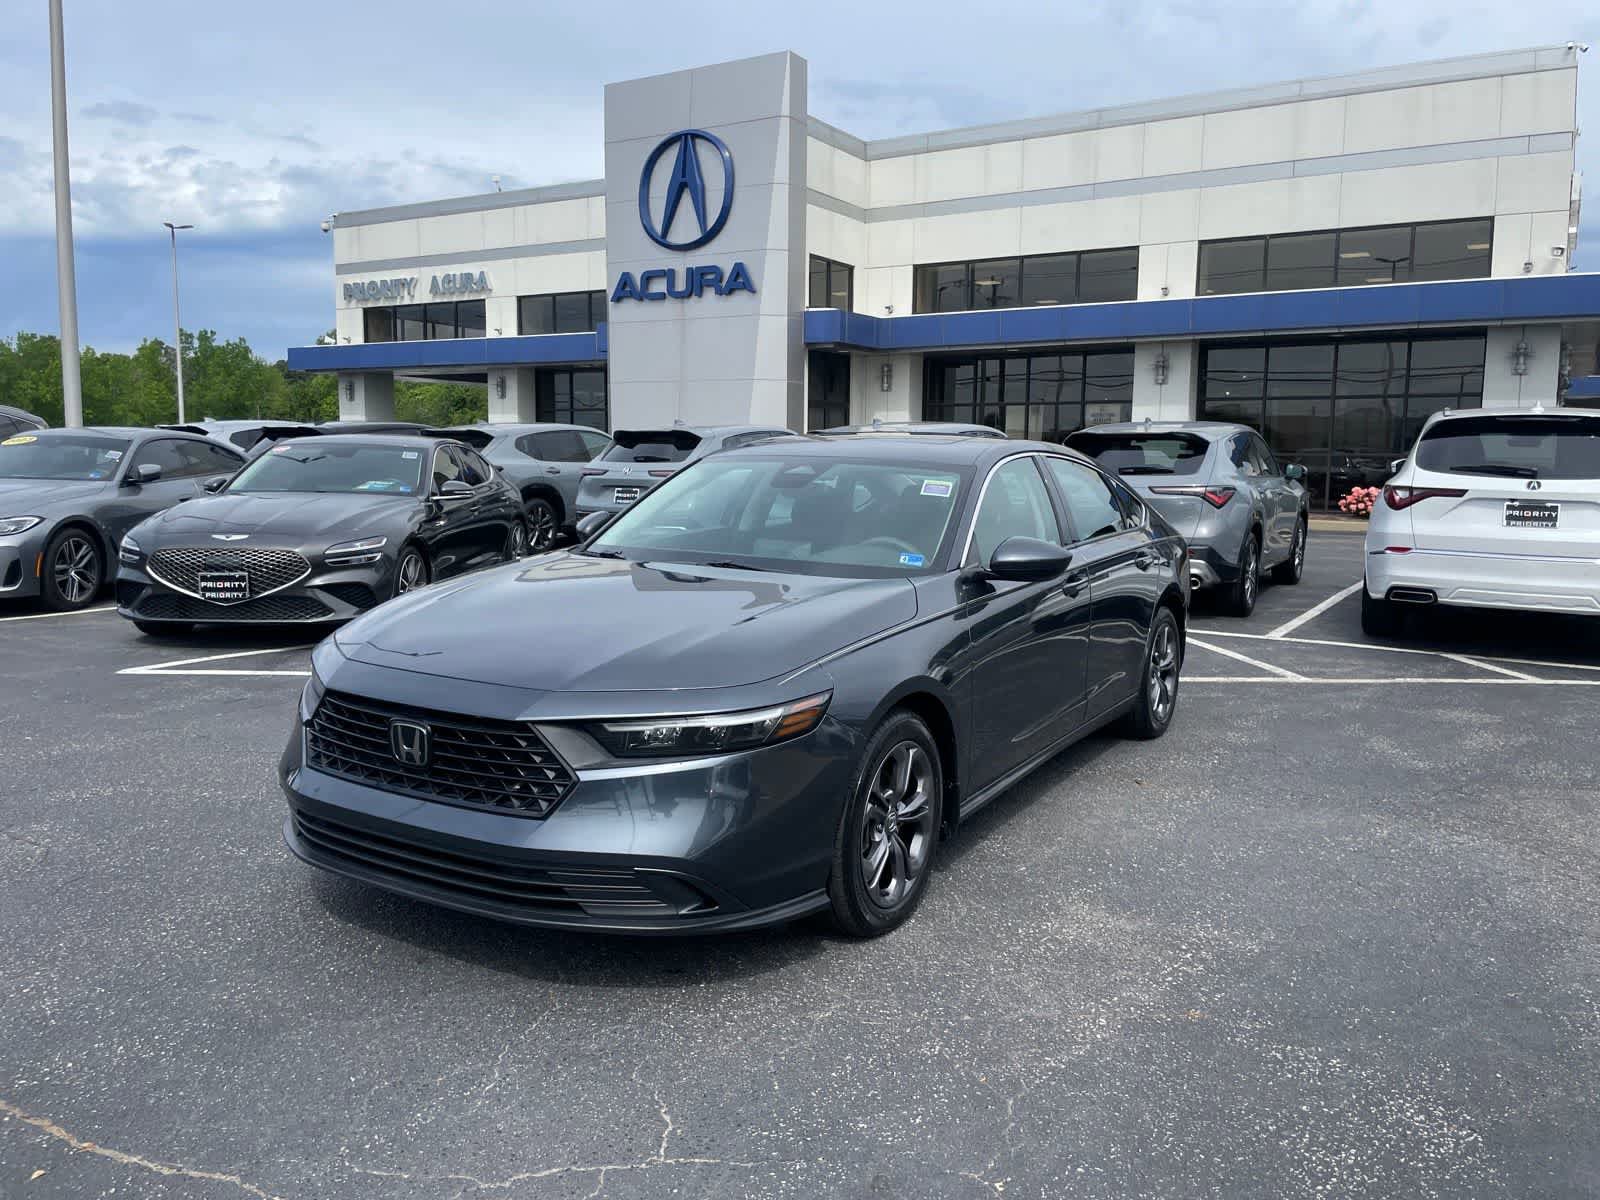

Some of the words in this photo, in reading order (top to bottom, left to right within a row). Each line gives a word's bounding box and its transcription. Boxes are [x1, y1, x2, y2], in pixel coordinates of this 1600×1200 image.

[342, 277, 417, 301] PRIORITY
[430, 270, 491, 297] ACURA
[610, 262, 756, 302] ACURA
